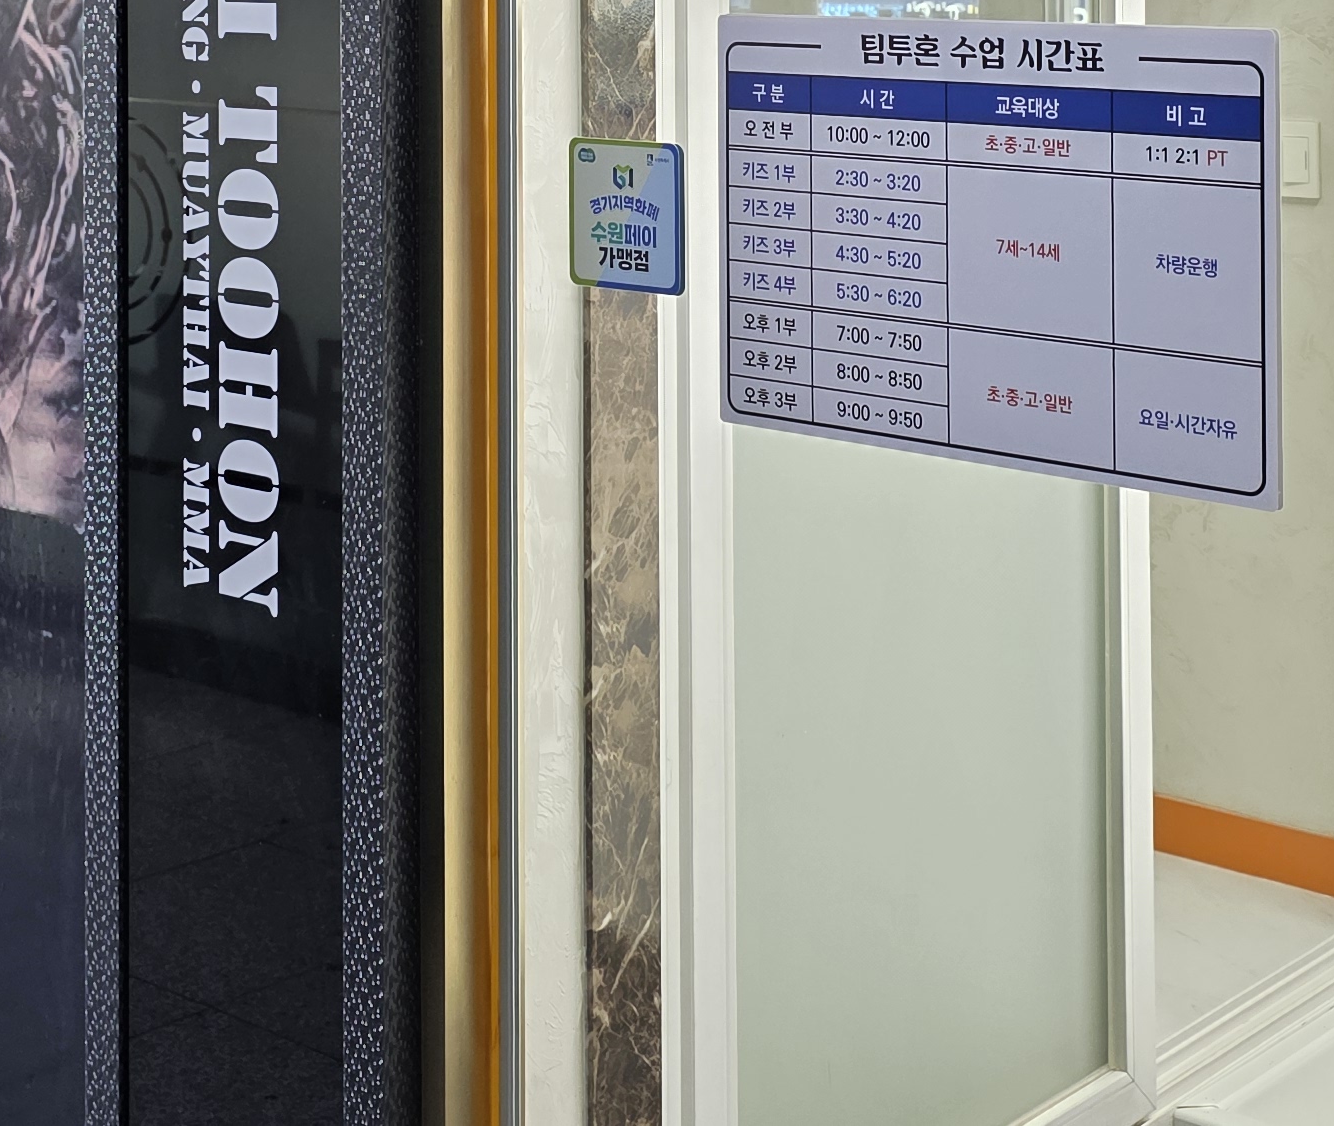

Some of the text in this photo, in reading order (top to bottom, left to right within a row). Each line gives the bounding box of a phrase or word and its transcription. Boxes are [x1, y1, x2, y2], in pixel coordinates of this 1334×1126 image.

[860, 33, 1105, 73] 팀투혼 수업 시간표
[995, 95, 1060, 120] 교육대상
[827, 125, 869, 145] 10:00
[887, 129, 931, 149] 12:00
[1145, 145, 1169, 164] 1:1
[1175, 147, 1200, 166] 2:1
[1206, 149, 1229, 167] PT
[742, 161, 770, 181] 키즈
[774, 164, 796, 183] 1부
[835, 169, 869, 188] 2:30
[886, 172, 921, 193] 3:20
[589, 194, 661, 222] 경기지역화폐
[742, 198, 770, 217] 키즈
[773, 201, 797, 221] 2부
[835, 206, 869, 226] 3:30
[886, 211, 922, 231] 4:20
[590, 221, 657, 249] 수원페이
[742, 234, 770, 254] 키즈
[773, 239, 797, 258] 3부
[835, 245, 869, 264] 4:30
[887, 250, 922, 270] 5:20
[182, 111, 211, 411] MUAYTHAI
[598, 246, 650, 273] 가맹점
[995, 238, 1219, 278] 7세~14세 차량운행
[742, 271, 770, 291] 키즈
[773, 275, 797, 295] 4부
[836, 282, 870, 303] 5:30
[887, 288, 922, 309] 6:20
[217, 85, 280, 618] TOOHON
[742, 313, 770, 334] 오후
[774, 317, 797, 337] 1부
[836, 325, 870, 345] 7:00
[887, 331, 922, 352] 7:50
[742, 350, 770, 371] 오후
[774, 354, 798, 374] 2부
[836, 363, 870, 384] 8:00
[887, 370, 923, 391] 8:50
[743, 386, 770, 408] 오후
[774, 391, 798, 412] 3부
[836, 401, 870, 422] 9:00
[888, 408, 923, 430] 9:50
[182, 457, 211, 588] MMA
